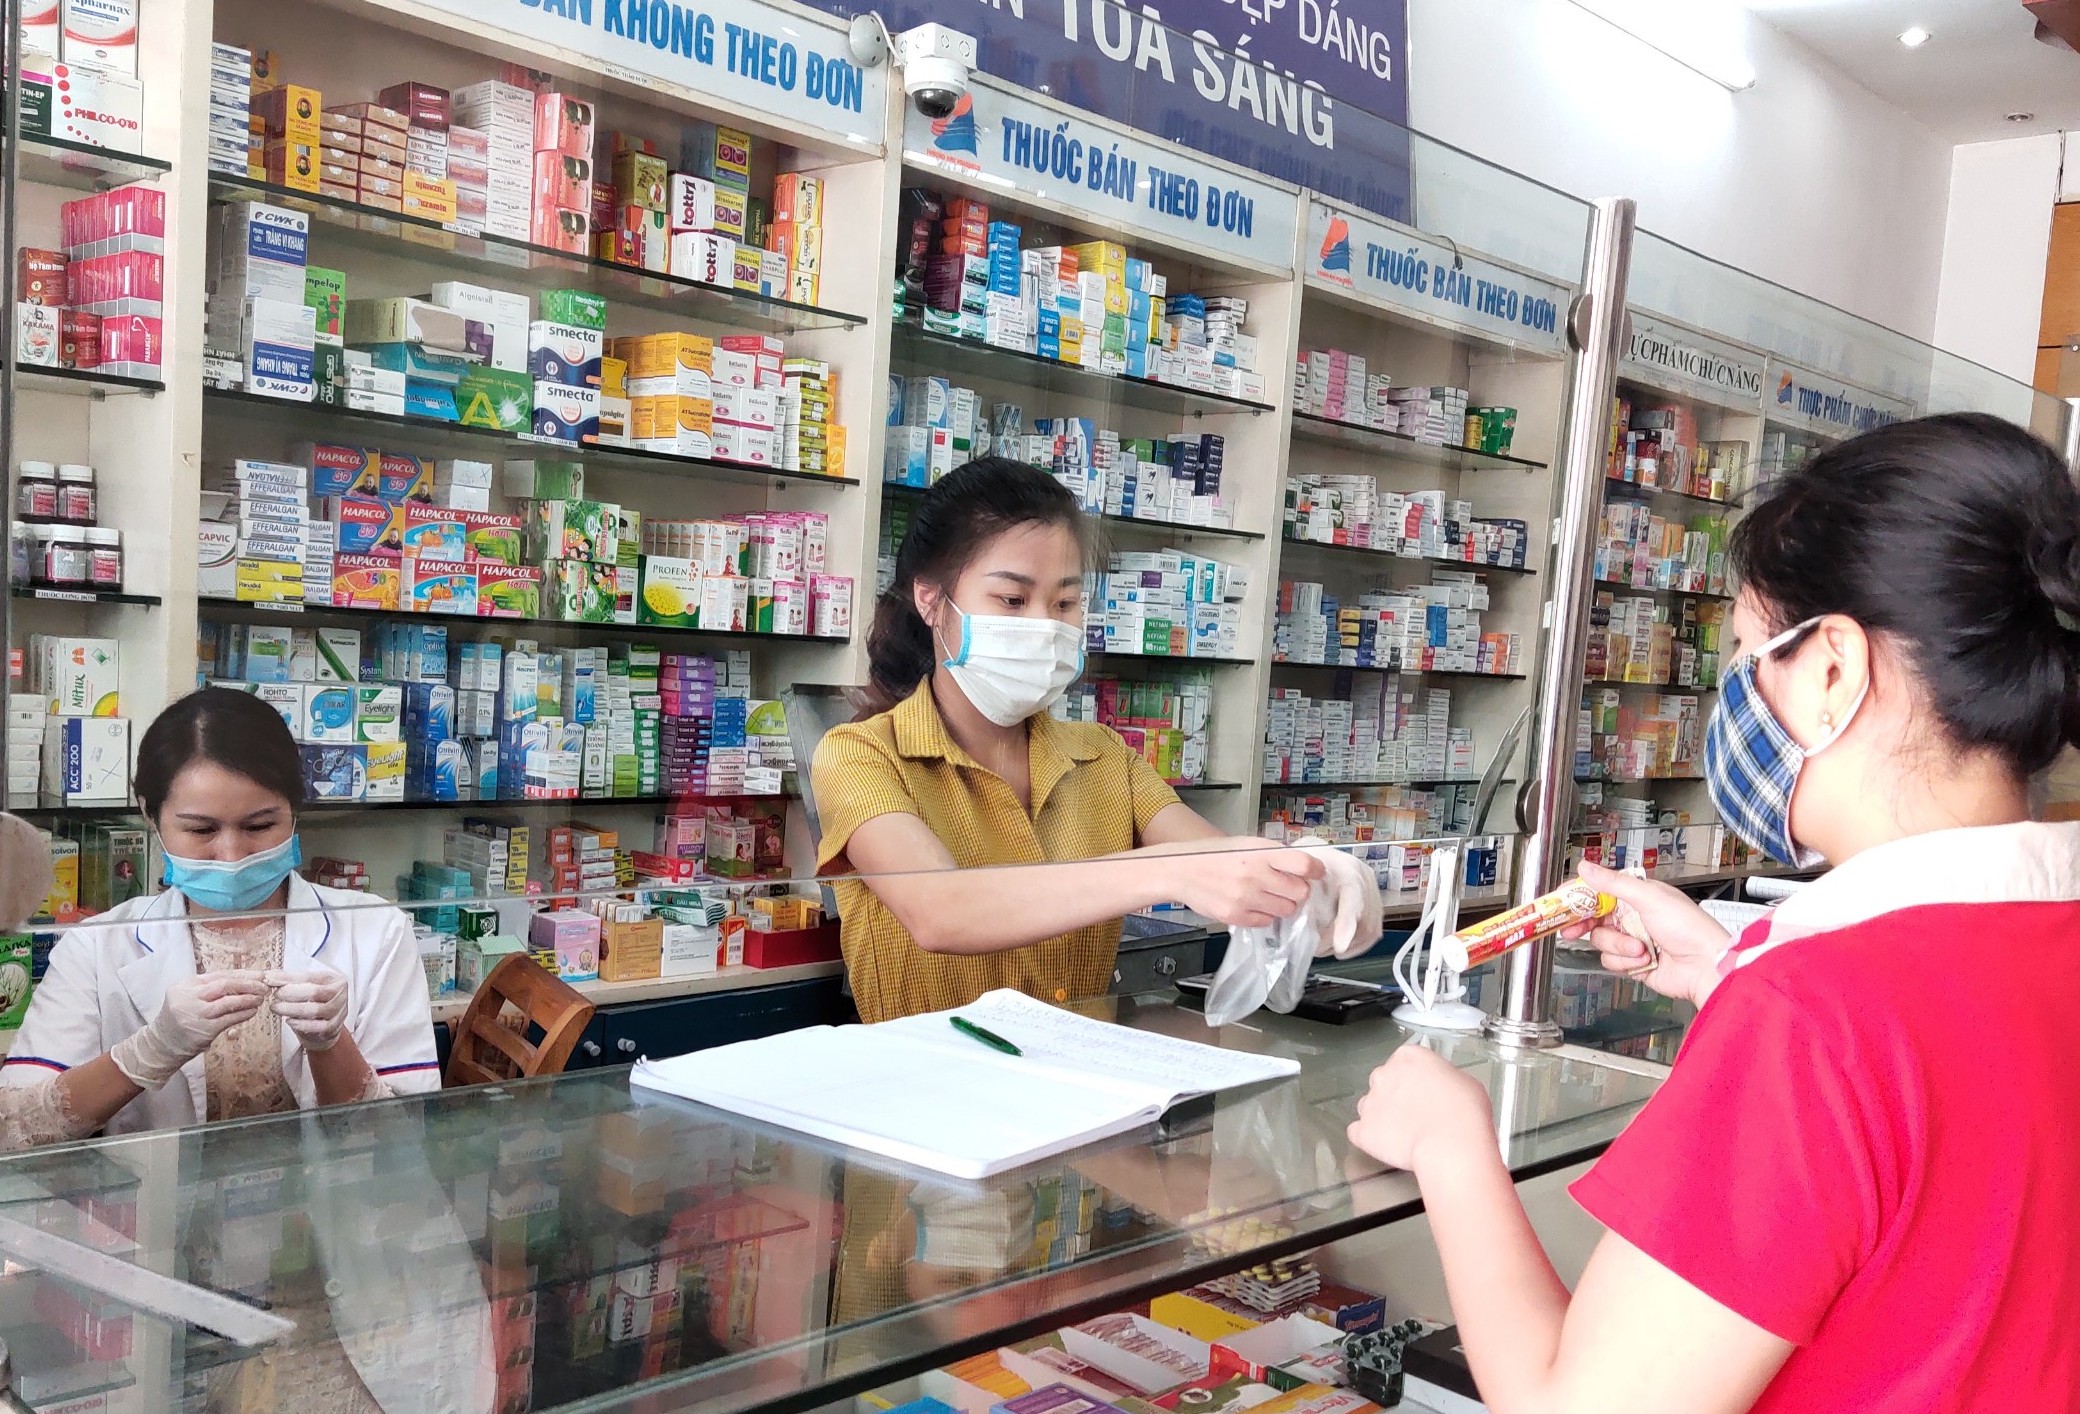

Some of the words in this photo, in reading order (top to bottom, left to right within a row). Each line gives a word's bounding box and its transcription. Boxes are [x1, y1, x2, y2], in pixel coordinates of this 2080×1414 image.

[1299, 0, 1392, 81] DÁNG
[725, 22, 798, 91] THEO
[805, 49, 864, 114] ĐƠN
[1193, 29, 1334, 149] SÁNG
[74, 107, 138, 130] PHILCO-Q10
[1001, 117, 1082, 182] THUỐC
[1088, 144, 1137, 203] BÁN
[1148, 165, 1198, 221] THEO
[1206, 186, 1254, 239] ĐƠN
[264, 212, 296, 226] CWK
[1366, 242, 1428, 294] THUỐC
[1476, 279, 1518, 322] THEO
[1521, 295, 1557, 334] ĐƠN
[548, 325, 597, 343] smecta
[326, 354, 334, 404] GASTRO
[267, 381, 299, 394] CWK
[547, 385, 595, 402] smecta
[316, 451, 362, 465] HAPACOL
[250, 483, 296, 496] EFFERALGAN
[250, 501, 298, 515] EFFERALGAN
[343, 506, 387, 520] HAPACOL
[410, 507, 457, 522] HAPACOL
[465, 514, 513, 527] HAPACOL
[252, 522, 299, 535] EFFERALGAN
[247, 541, 295, 553] EFFERALGAN
[237, 561, 259, 570] Panadol
[338, 554, 390, 568] HAPACOL
[418, 560, 468, 574] HAPACOL
[364, 569, 387, 584] 250
[482, 565, 532, 578] HAPACOL
[652, 564, 688, 576] PROFEN
[238, 581, 261, 590] Panadol
[72, 673, 86, 708] Mitux
[431, 690, 453, 699] Otrivin
[364, 703, 395, 714] Eyelight
[523, 729, 547, 737] Otrivin
[564, 727, 584, 736] Otrivin
[70, 744, 80, 769] 200
[437, 746, 460, 755] Otrivin
[69, 770, 80, 790] ACC
[1505, 929, 1526, 948] MAX
